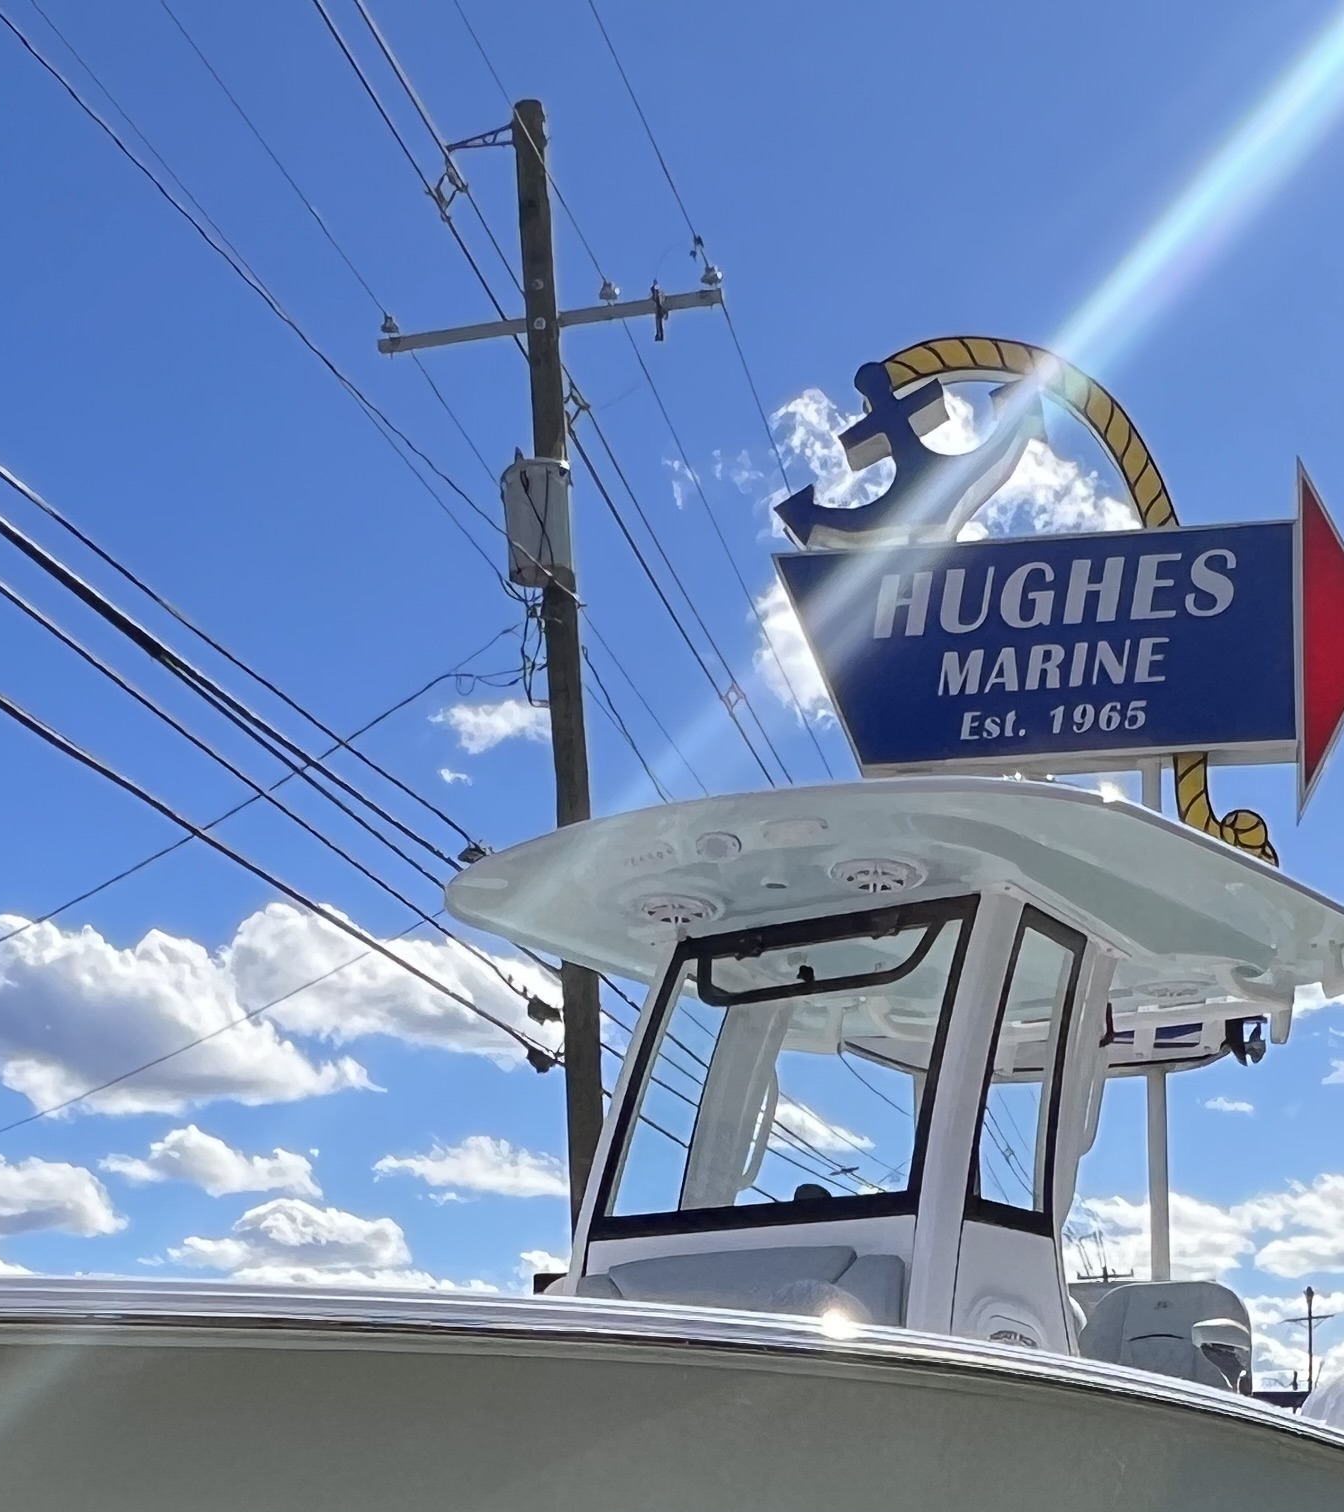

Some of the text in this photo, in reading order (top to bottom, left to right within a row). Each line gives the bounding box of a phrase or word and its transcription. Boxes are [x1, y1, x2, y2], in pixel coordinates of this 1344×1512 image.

[873, 548, 1237, 640] HUGHES
[937, 637, 1171, 696] MARINE
[959, 699, 1148, 741] Est. 1965
